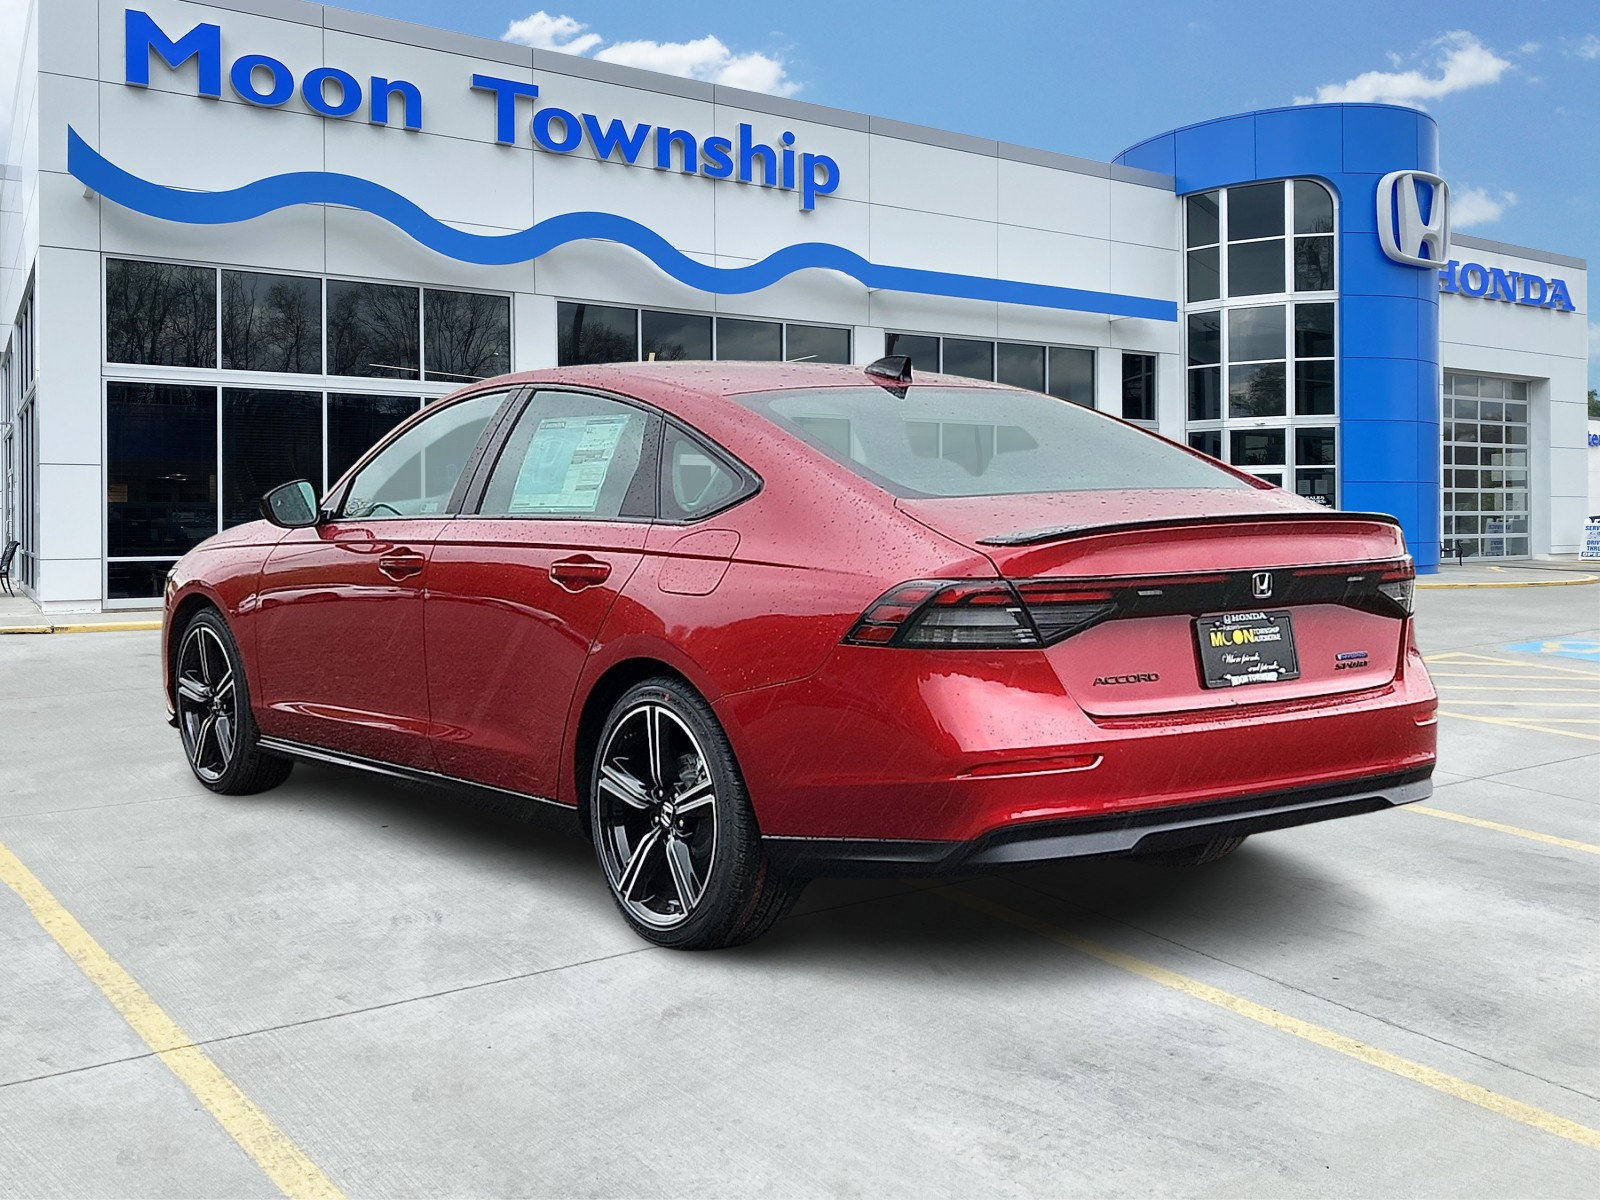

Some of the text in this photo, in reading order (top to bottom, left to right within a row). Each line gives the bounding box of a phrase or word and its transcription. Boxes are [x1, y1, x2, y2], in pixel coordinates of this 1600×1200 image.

[124, 8, 841, 212] Moon Township
[1438, 259, 1577, 312] HONDA
[1231, 612, 1268, 622] HONDA
[1092, 673, 1160, 687] ACCORD
